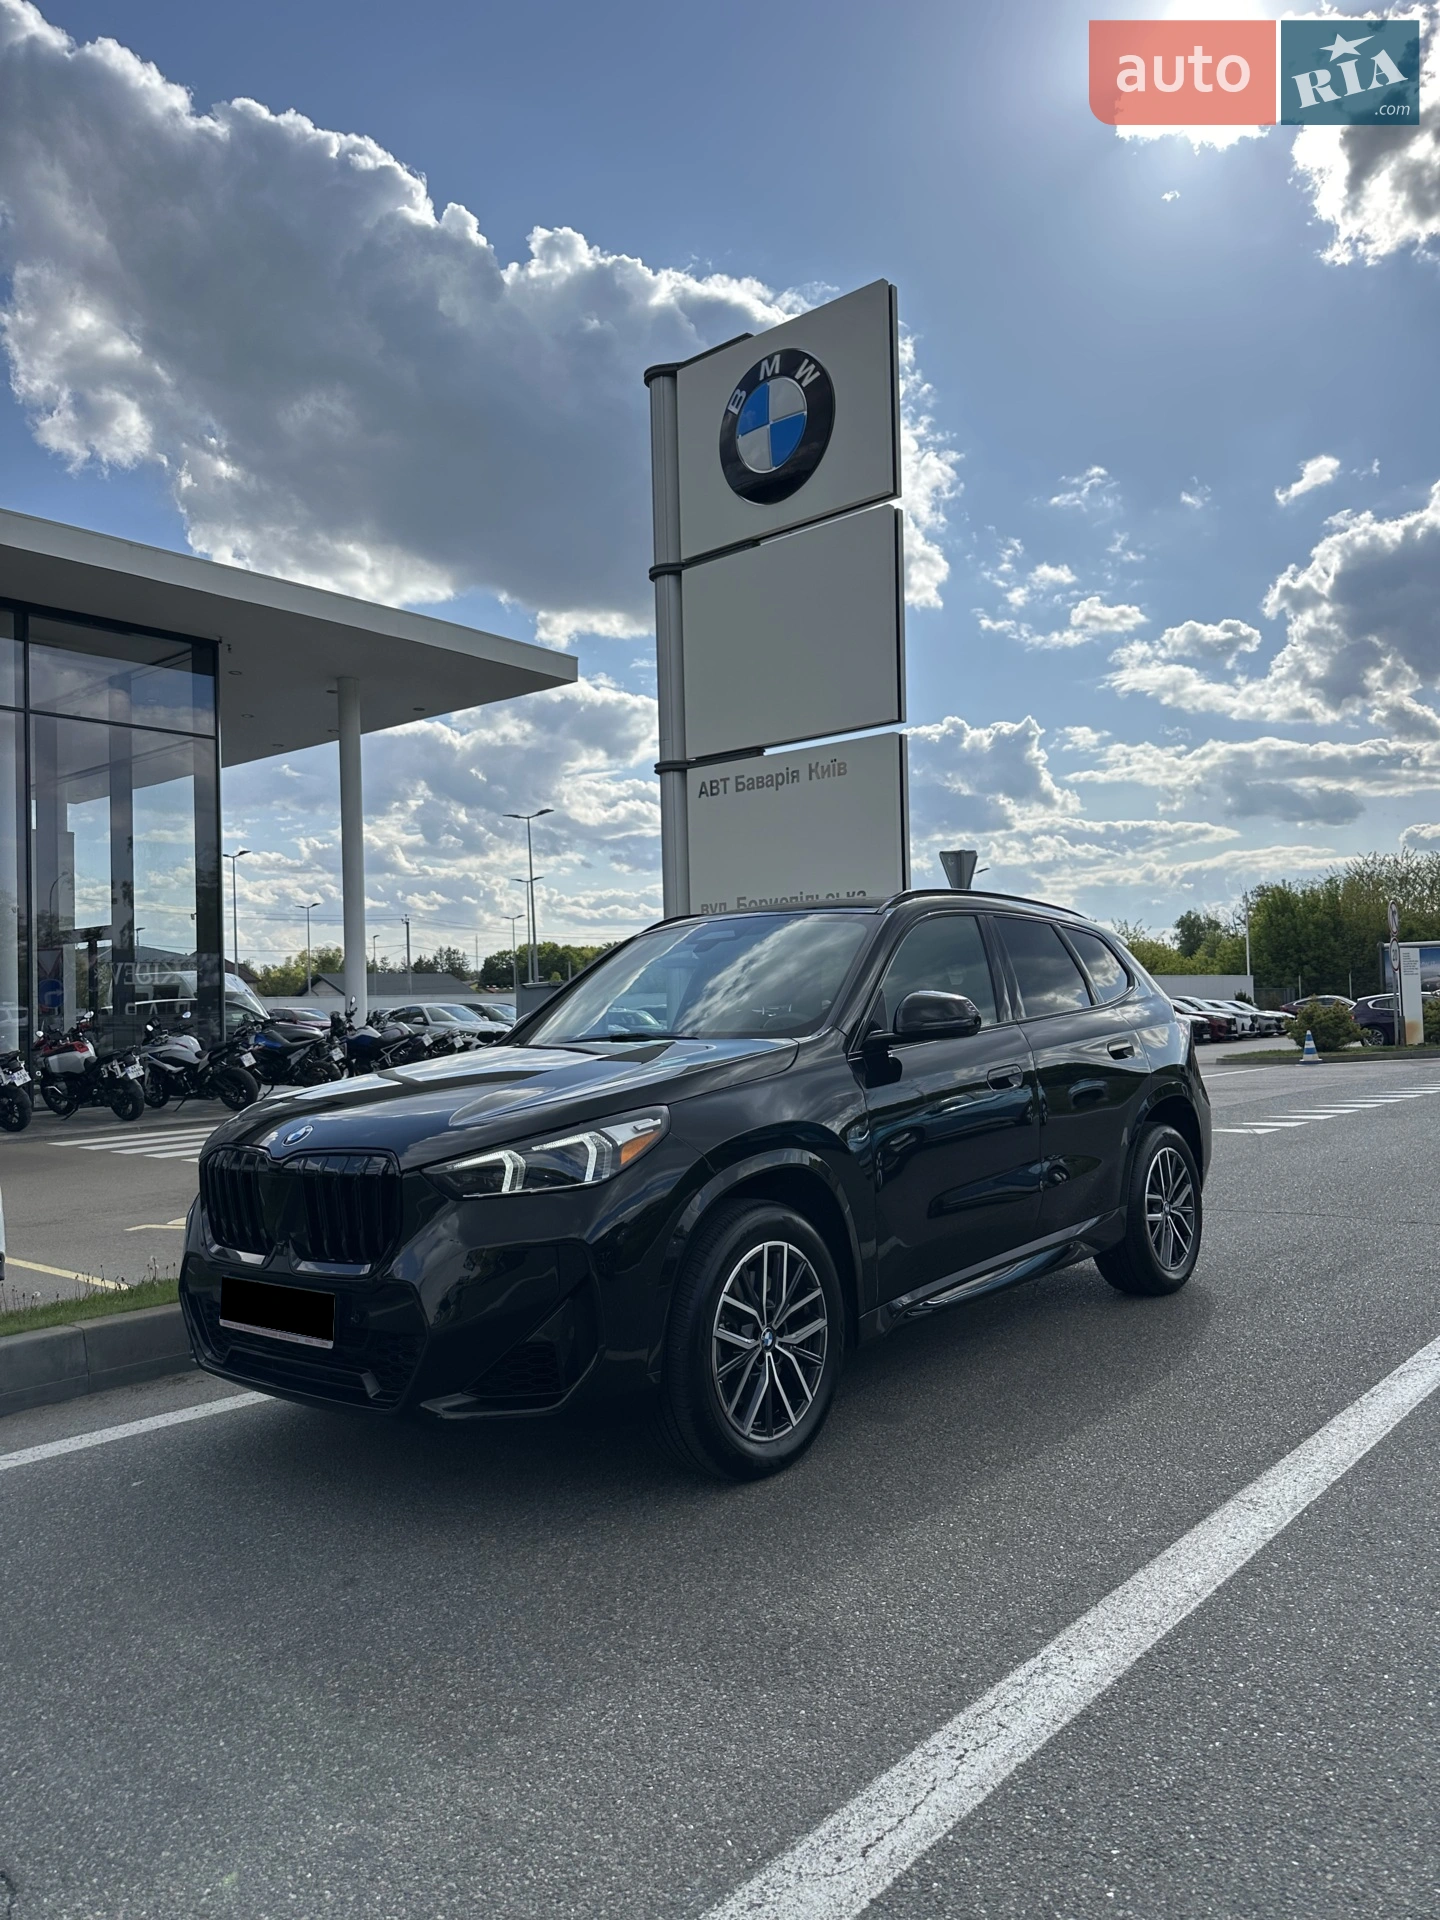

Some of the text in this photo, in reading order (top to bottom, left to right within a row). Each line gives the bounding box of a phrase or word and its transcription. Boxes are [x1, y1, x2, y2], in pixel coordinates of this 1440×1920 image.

[728, 354, 820, 415] BMW
[698, 758, 848, 798] АВТ Баварія Київ
